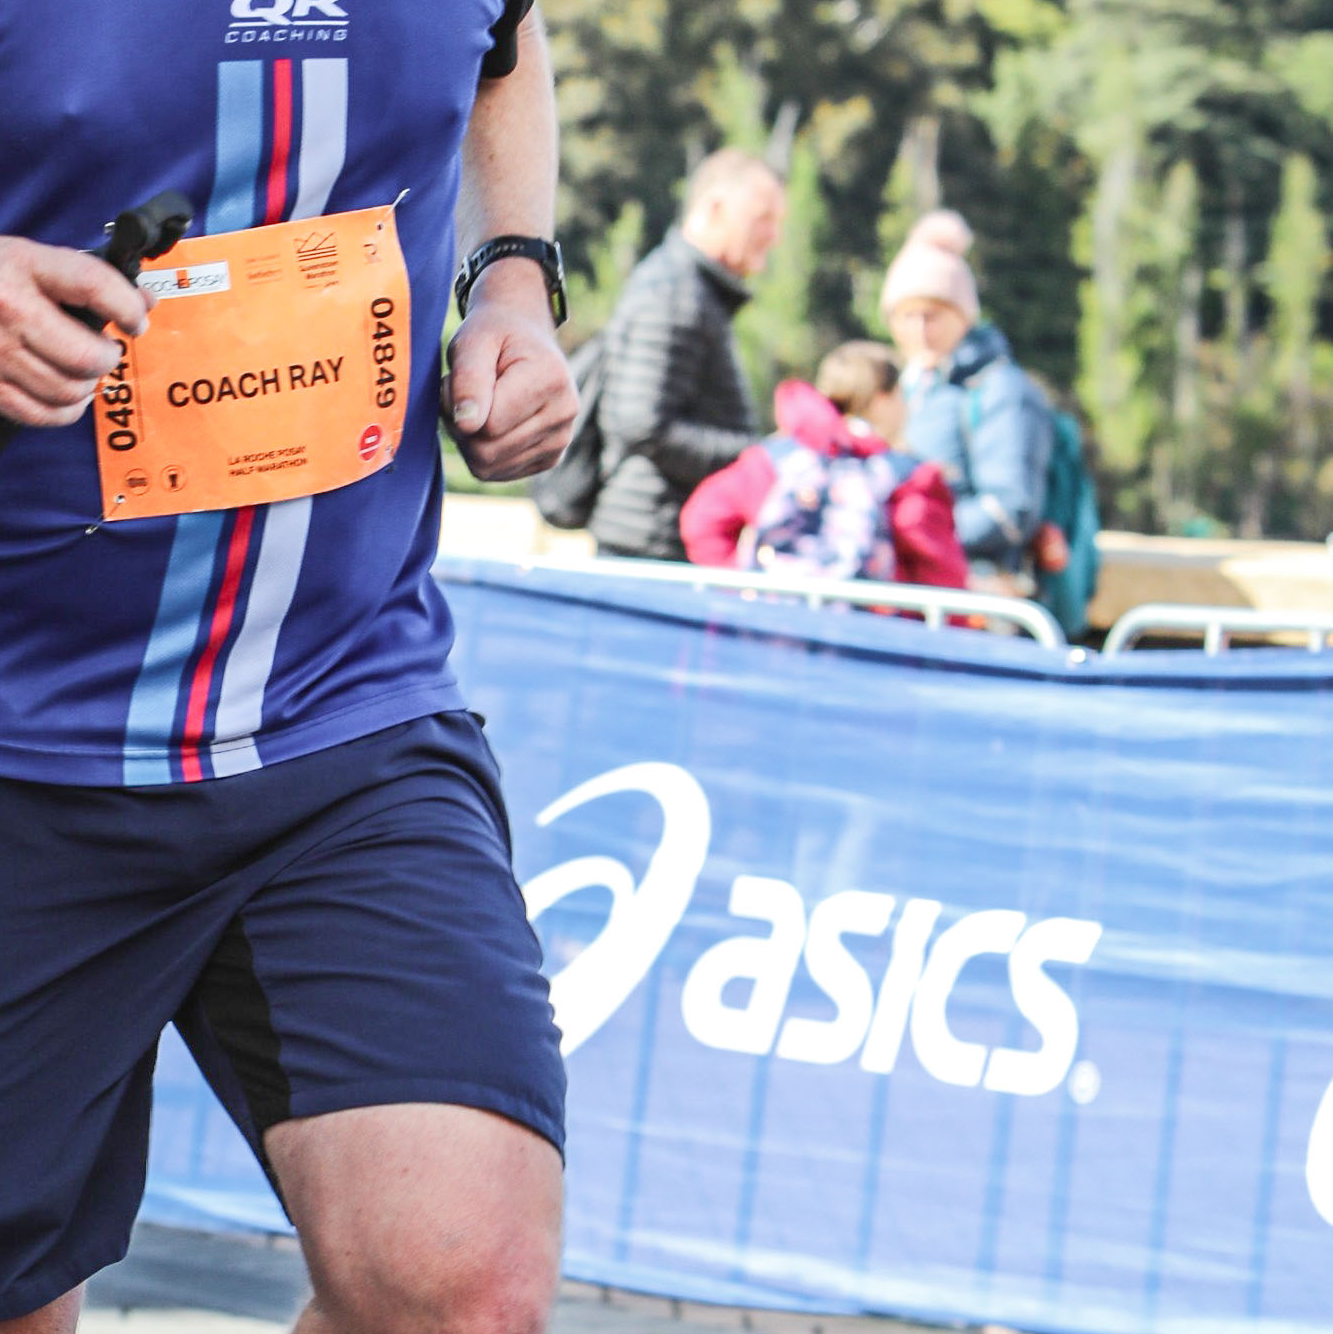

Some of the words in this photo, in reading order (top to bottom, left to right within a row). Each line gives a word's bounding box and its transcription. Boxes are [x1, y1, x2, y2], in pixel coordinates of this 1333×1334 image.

[224, 29, 348, 43] COACHING
[167, 368, 281, 408] COACH
[289, 356, 344, 391] RAY
[371, 297, 396, 409] 04849
[681, 874, 1103, 1096] asics
